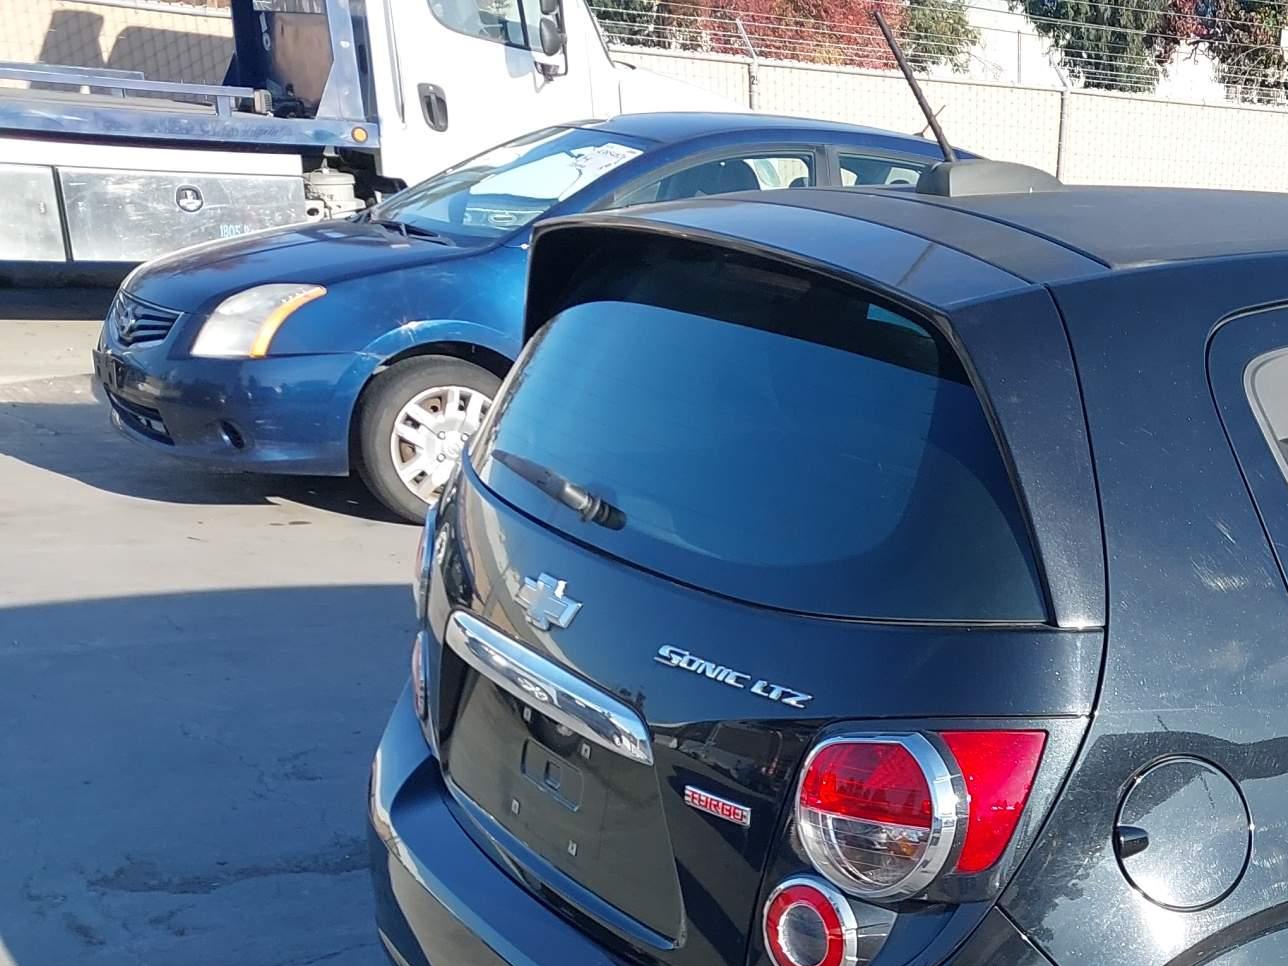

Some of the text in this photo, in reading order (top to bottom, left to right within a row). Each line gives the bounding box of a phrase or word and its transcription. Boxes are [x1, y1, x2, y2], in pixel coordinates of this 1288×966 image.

[653, 644, 814, 709] SONIC LTZ
[685, 786, 751, 825] TURBO
